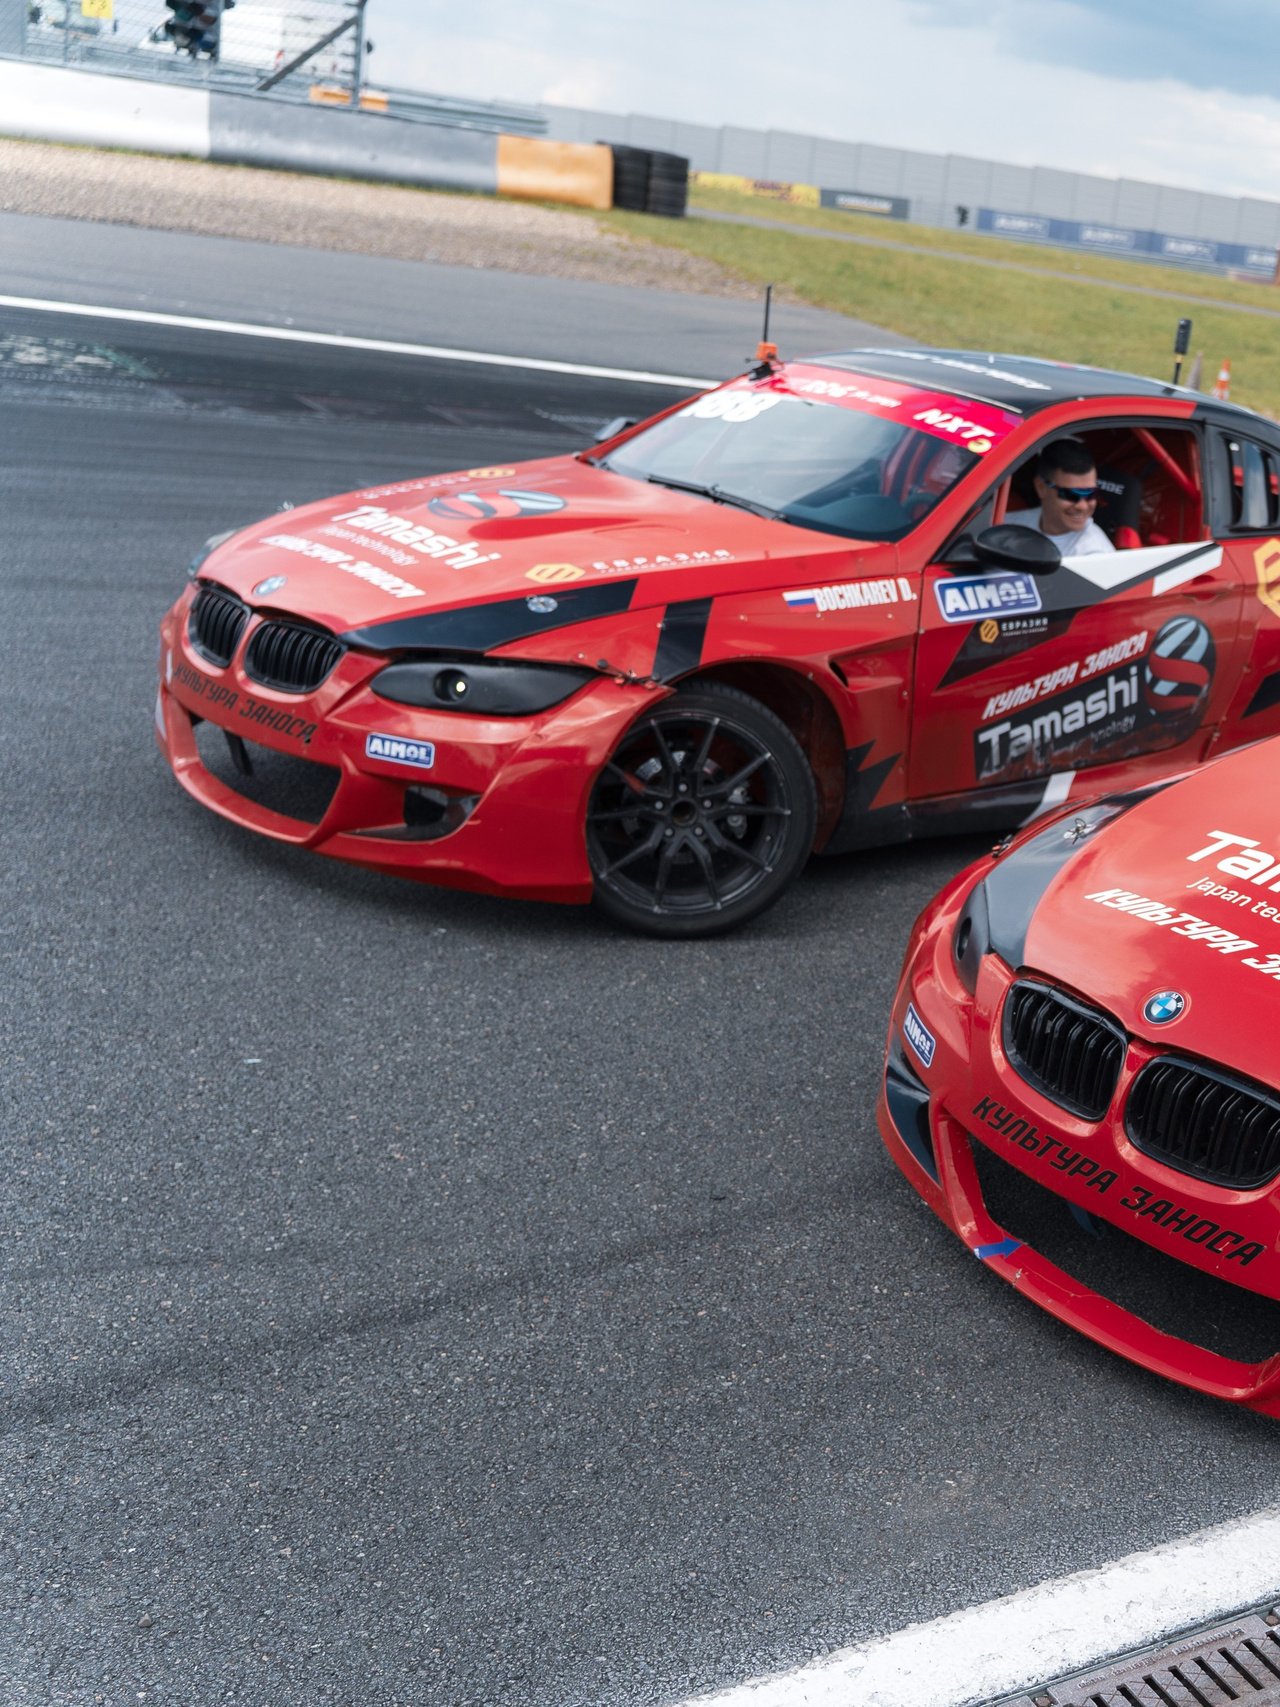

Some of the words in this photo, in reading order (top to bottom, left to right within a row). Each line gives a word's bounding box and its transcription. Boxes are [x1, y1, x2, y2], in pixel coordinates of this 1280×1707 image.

[914, 408, 996, 440] NXT
[331, 505, 502, 570] Tamashi
[592, 549, 730, 571] ЕВРАЗИЯ
[814, 579, 898, 612] BOCHKAREV
[897, 577, 917, 602] D.
[944, 579, 1035, 614] AIMOL
[1001, 617, 1049, 632] ЕВРАЗИЯ
[981, 661, 1079, 720] КУЛЬТУРА
[1080, 630, 1148, 679] ЗАНОСА
[173, 663, 239, 712] КУЛЬТУРА
[239, 698, 318, 739] ЗАНОСА
[978, 665, 1139, 768] Tamashi
[369, 736, 432, 764] AIMOL
[1186, 876, 1252, 908] Japan
[1084, 888, 1259, 955] КУЛЬТУРА
[905, 1011, 931, 1061] AIMOL
[971, 1095, 1120, 1194] КУЛЬТУРА
[1119, 1185, 1267, 1267] ЗАНОСА
